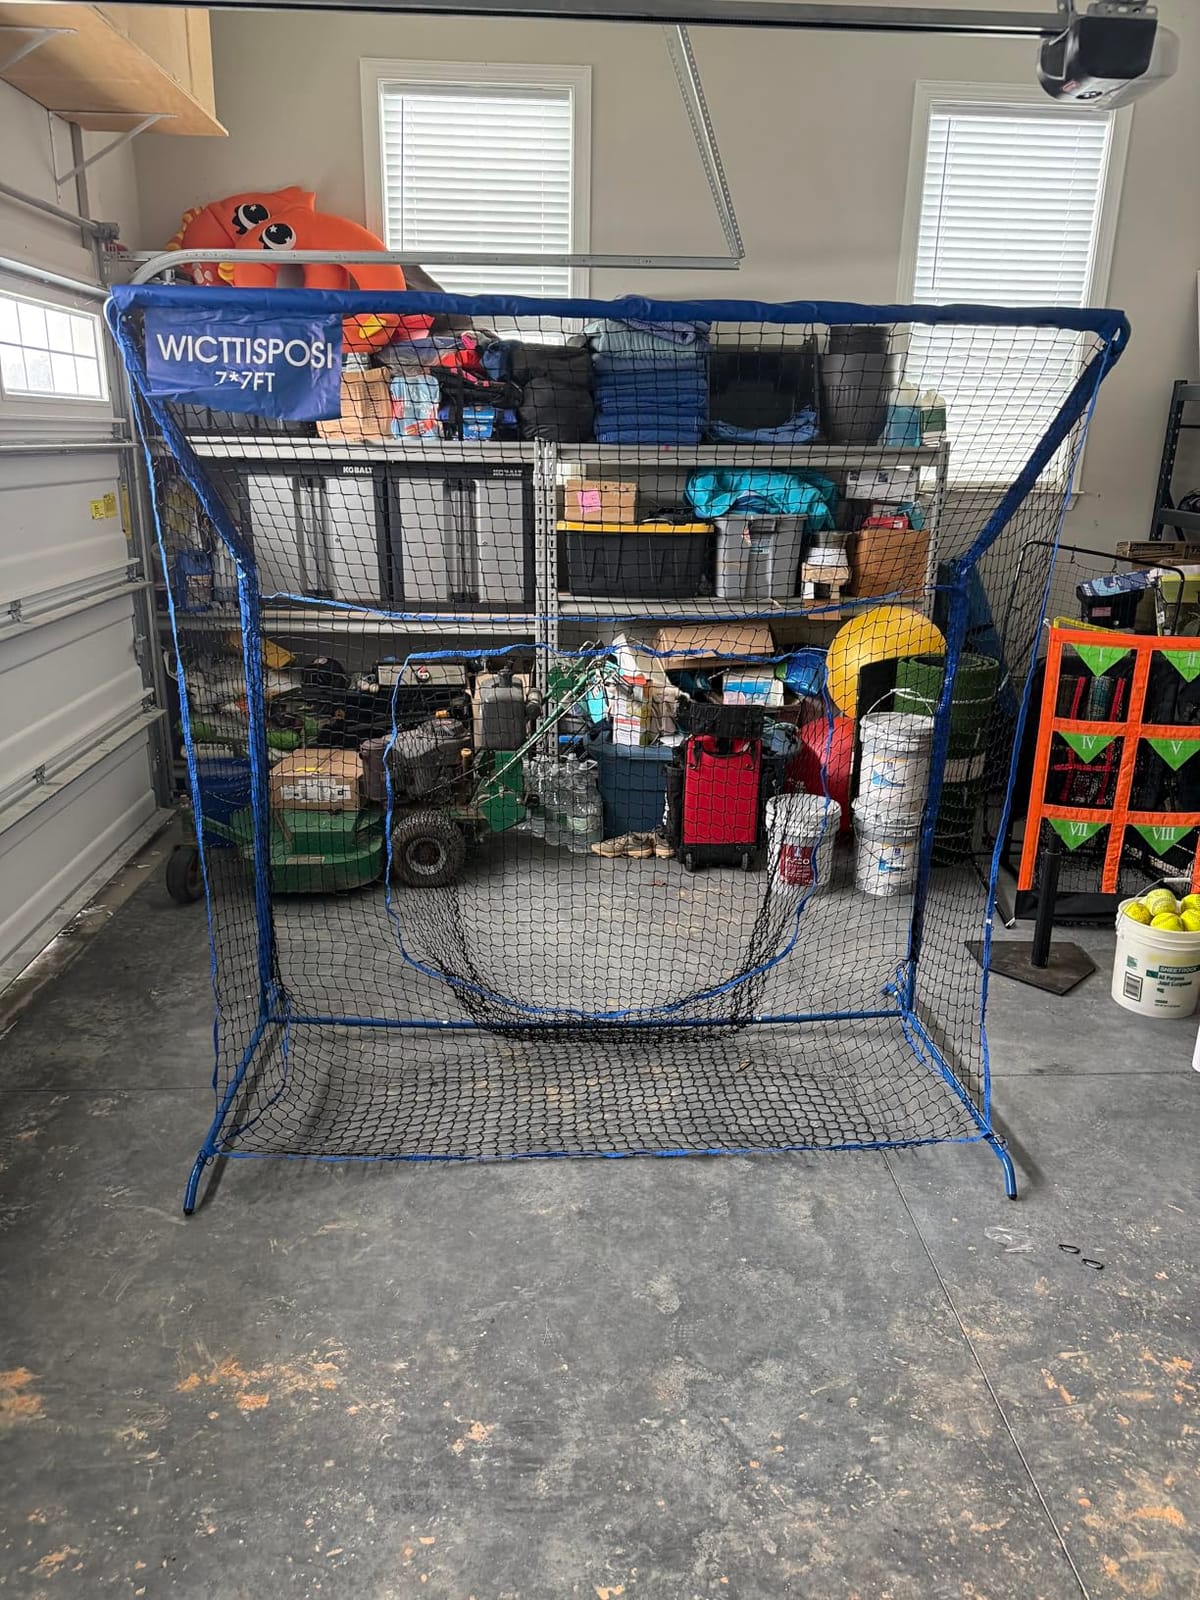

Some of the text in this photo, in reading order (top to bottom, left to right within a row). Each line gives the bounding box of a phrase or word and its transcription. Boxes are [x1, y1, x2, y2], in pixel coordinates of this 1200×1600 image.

[156, 334, 334, 369] WICTTISPOSI
[342, 466, 374, 474] KOBALT
[1082, 736, 1097, 750] IV
[1171, 741, 1182, 755] V
[1069, 823, 1089, 837] VII
[1152, 827, 1176, 841] VIII
